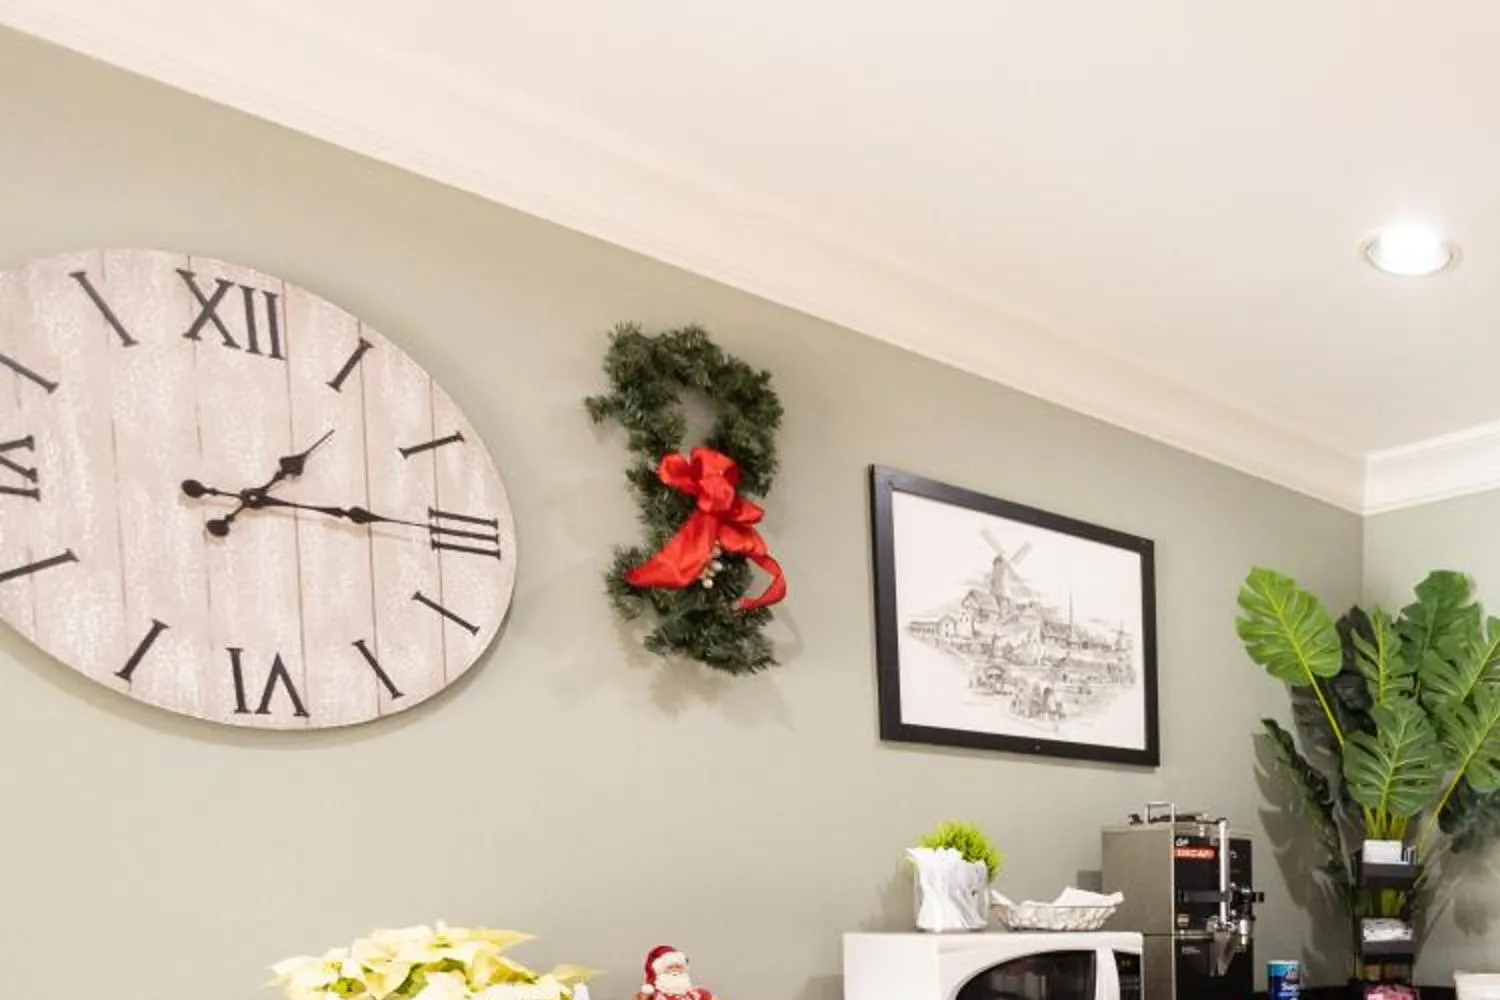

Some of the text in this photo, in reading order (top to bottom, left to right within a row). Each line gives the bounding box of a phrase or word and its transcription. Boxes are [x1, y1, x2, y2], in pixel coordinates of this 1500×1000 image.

[176, 269, 286, 361] XII
[428, 506, 501, 560] III
[226, 647, 310, 719] VI
